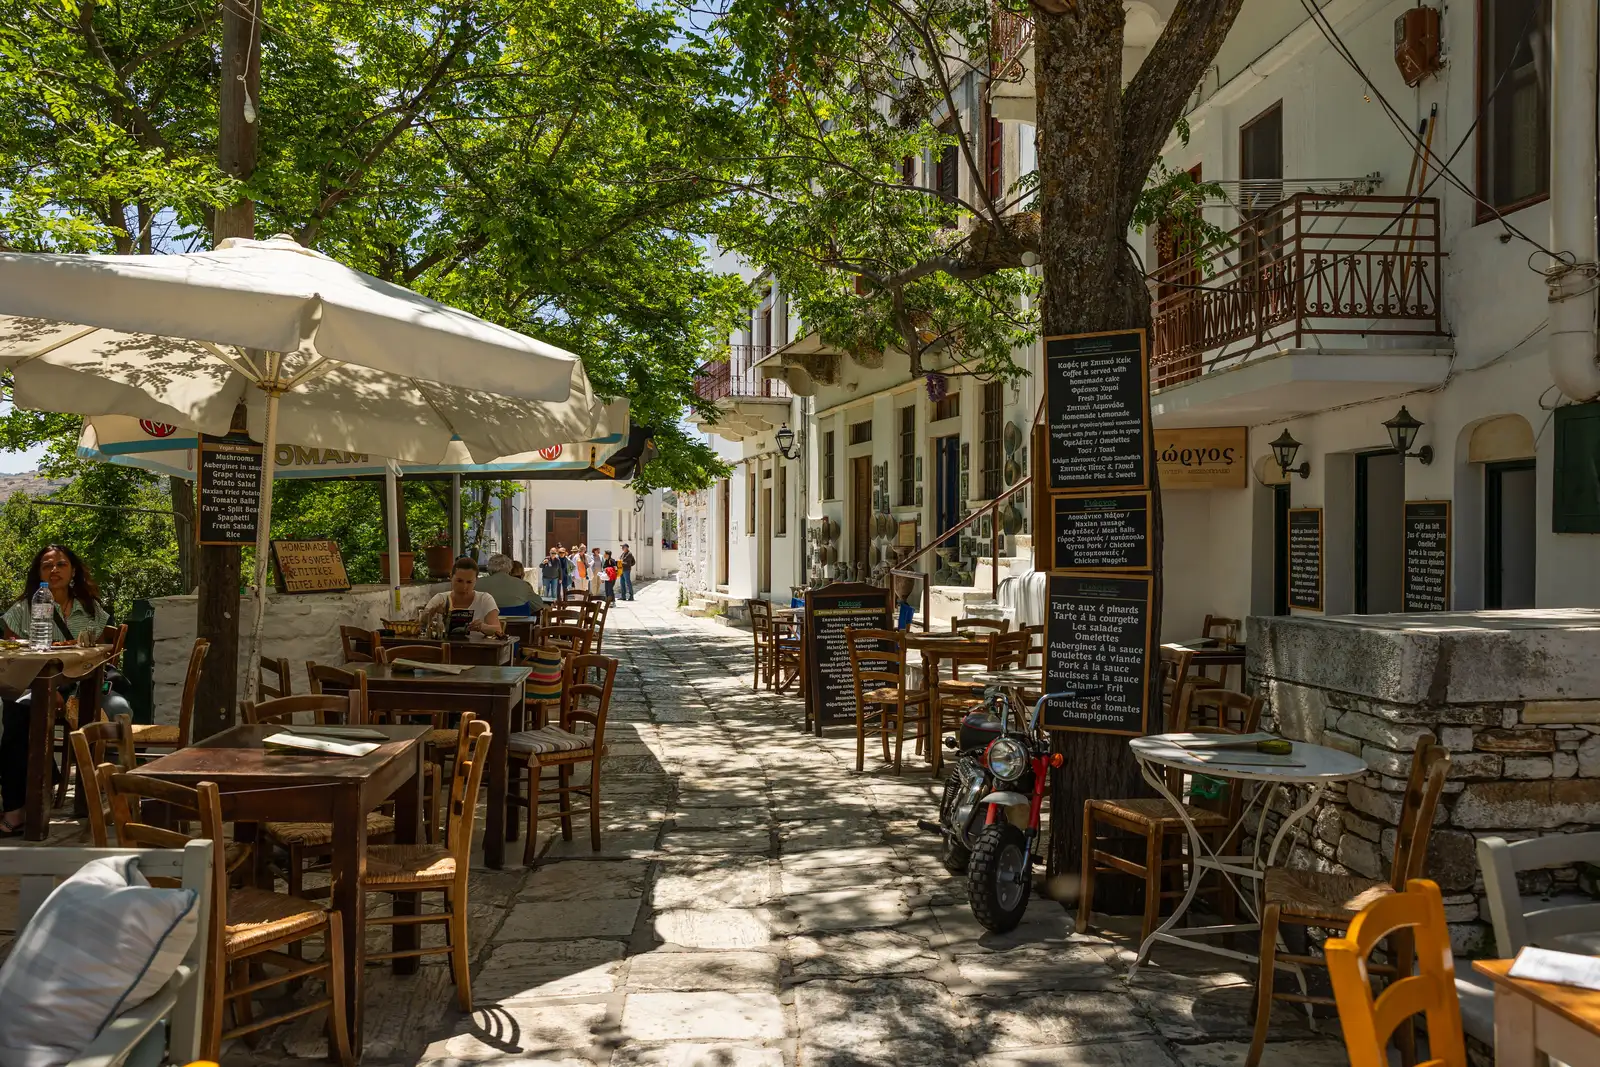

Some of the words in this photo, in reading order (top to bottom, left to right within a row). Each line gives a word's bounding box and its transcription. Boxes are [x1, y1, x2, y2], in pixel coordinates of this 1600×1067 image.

[1078, 393, 1094, 401] Fresh
[1098, 410, 1130, 418] Lemonade
[216, 454, 254, 462] Mushrooms
[1154, 444, 1234, 466] ιώργος
[204, 462, 238, 470] Aubergines
[1059, 472, 1092, 480] Homemade
[282, 542, 327, 552] HOMEMADE
[280, 556, 300, 564] PIES
[309, 555, 340, 564] SWEETS
[1427, 568, 1444, 576] Fromage
[1052, 602, 1074, 610] Tarte
[1107, 605, 1138, 614] pinards
[1054, 612, 1077, 620] Tarte
[1089, 613, 1096, 621] la
[1100, 615, 1138, 625] courgette
[1090, 624, 1122, 633] salades
[1075, 633, 1119, 642] Omelettes
[1050, 641, 1096, 651] Aubergines
[1120, 646, 1143, 654] sauce
[1052, 651, 1092, 660] Boulettes
[1096, 654, 1106, 662] de
[1110, 655, 1140, 664] viande
[1059, 661, 1079, 669] Pork
[1104, 665, 1129, 673] sauce
[1049, 670, 1089, 680] Saucisses
[1102, 674, 1110, 682] la
[1114, 675, 1139, 684] sauce
[1107, 684, 1123, 692] Frit
[1105, 694, 1126, 702] local
[1048, 700, 1088, 709] Boulettes
[1091, 702, 1101, 710] de
[1105, 704, 1140, 713] tomates
[1063, 710, 1124, 722] Champignons
